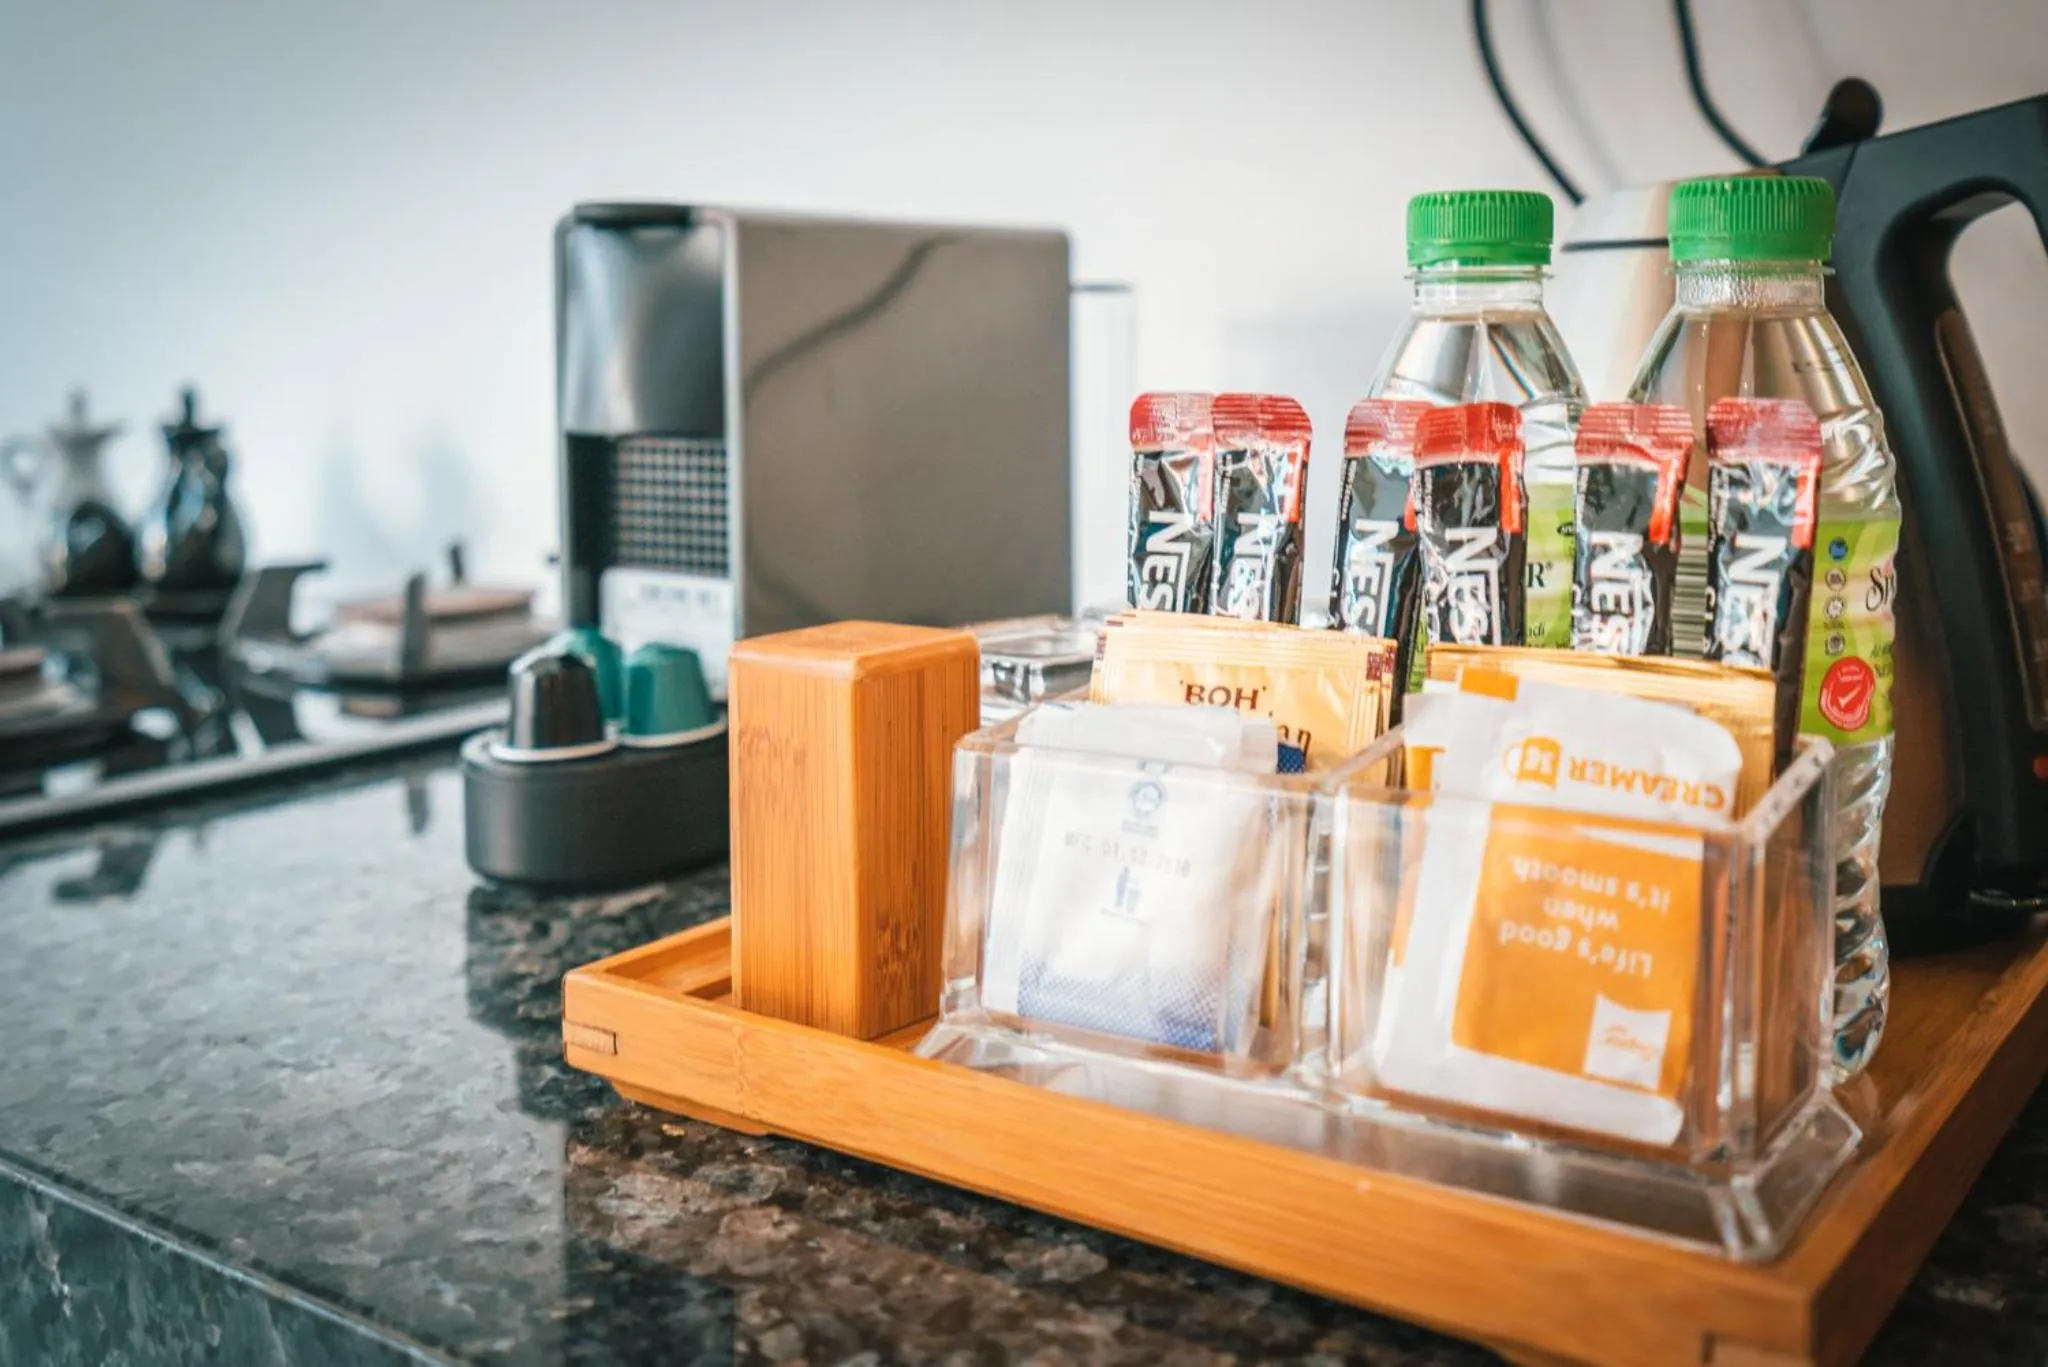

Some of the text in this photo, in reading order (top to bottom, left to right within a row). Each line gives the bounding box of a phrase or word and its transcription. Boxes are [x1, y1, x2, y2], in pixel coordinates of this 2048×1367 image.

[1568, 756, 1726, 811] CREAMER
[1543, 898, 1619, 932] when
[1626, 882, 1671, 915] it's
[1499, 920, 1652, 979] Life's good
